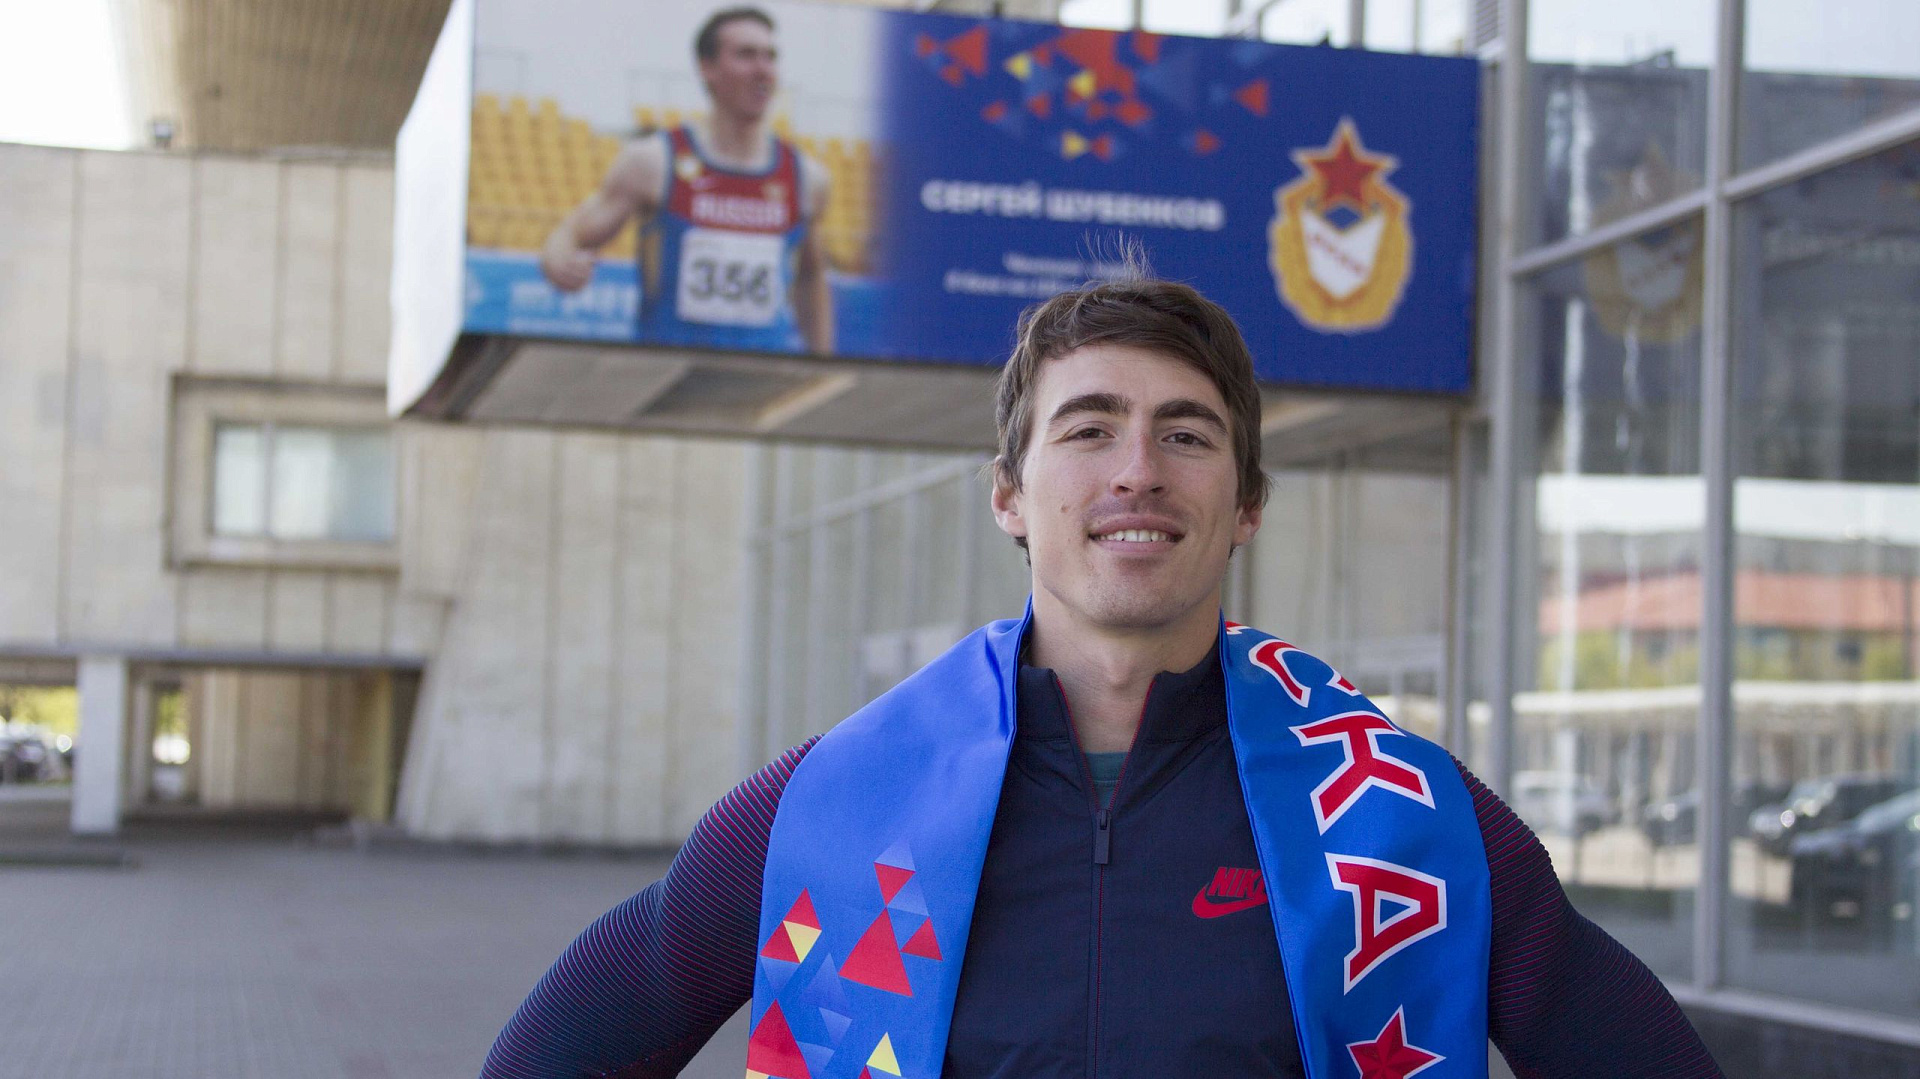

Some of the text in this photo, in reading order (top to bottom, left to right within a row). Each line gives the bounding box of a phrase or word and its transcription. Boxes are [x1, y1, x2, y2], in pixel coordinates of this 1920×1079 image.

[691, 193, 788, 227] RUSSIA
[923, 180, 1225, 230] СЕРГЕЙ ШУБЕНКОВ
[690, 260, 771, 304] 356
[1224, 620, 1447, 996] СКА
